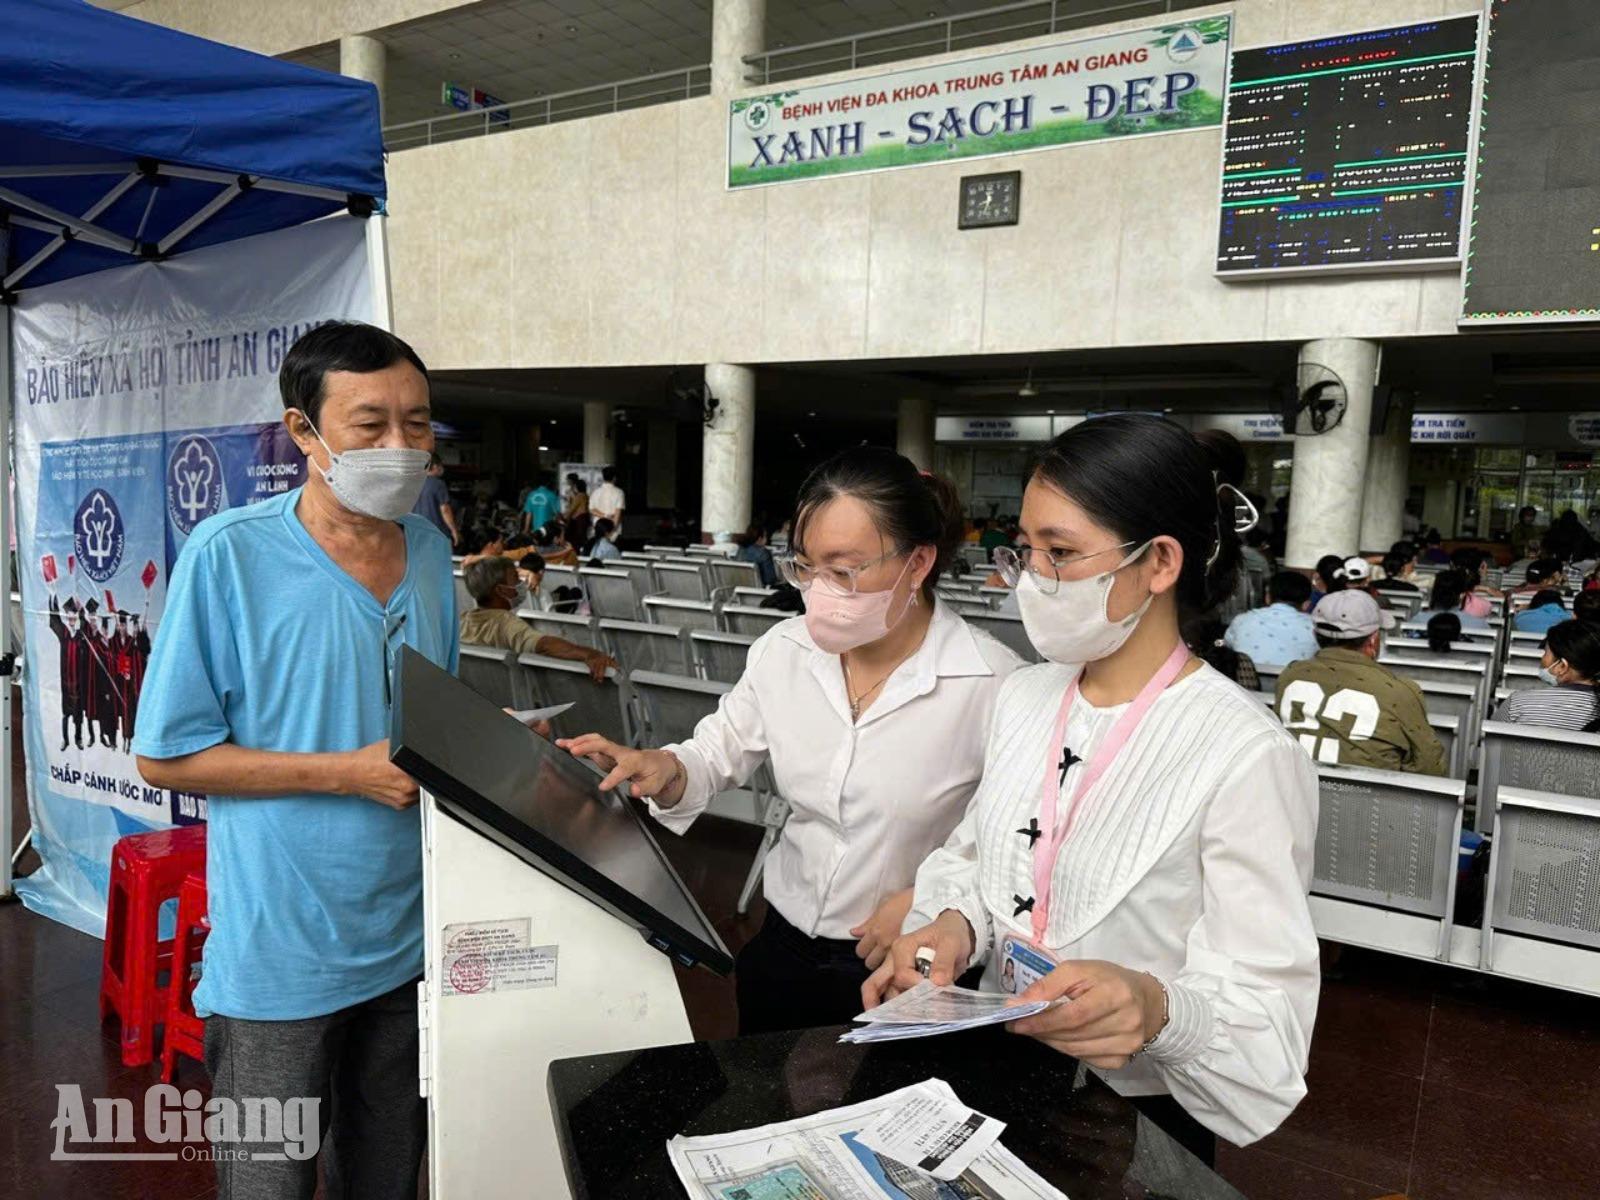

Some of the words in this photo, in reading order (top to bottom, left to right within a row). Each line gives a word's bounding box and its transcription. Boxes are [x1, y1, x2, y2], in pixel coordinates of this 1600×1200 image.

[750, 121, 864, 168] XANH
[907, 95, 1034, 150] SẠCH
[1084, 71, 1199, 126] ĐẸP
[782, 102, 822, 121] BỆNH
[827, 95, 861, 113] VIỆN
[866, 91, 888, 107] ĐA
[892, 83, 940, 102] KHOA
[944, 72, 1004, 93] TRUNG
[1010, 64, 1048, 83] TÂM
[1052, 59, 1079, 77] AN
[1085, 48, 1149, 71] GIANG
[27, 356, 59, 405] BẢO
[64, 350, 104, 400] HIỂM
[109, 341, 133, 394] XÃ
[139, 335, 168, 400] HỘI
[174, 329, 220, 385] TỈNH
[227, 331, 258, 379] AN
[51, 763, 81, 785] CHẮP
[84, 772, 116, 792] CÁNH
[143, 787, 163, 806] MƠ
